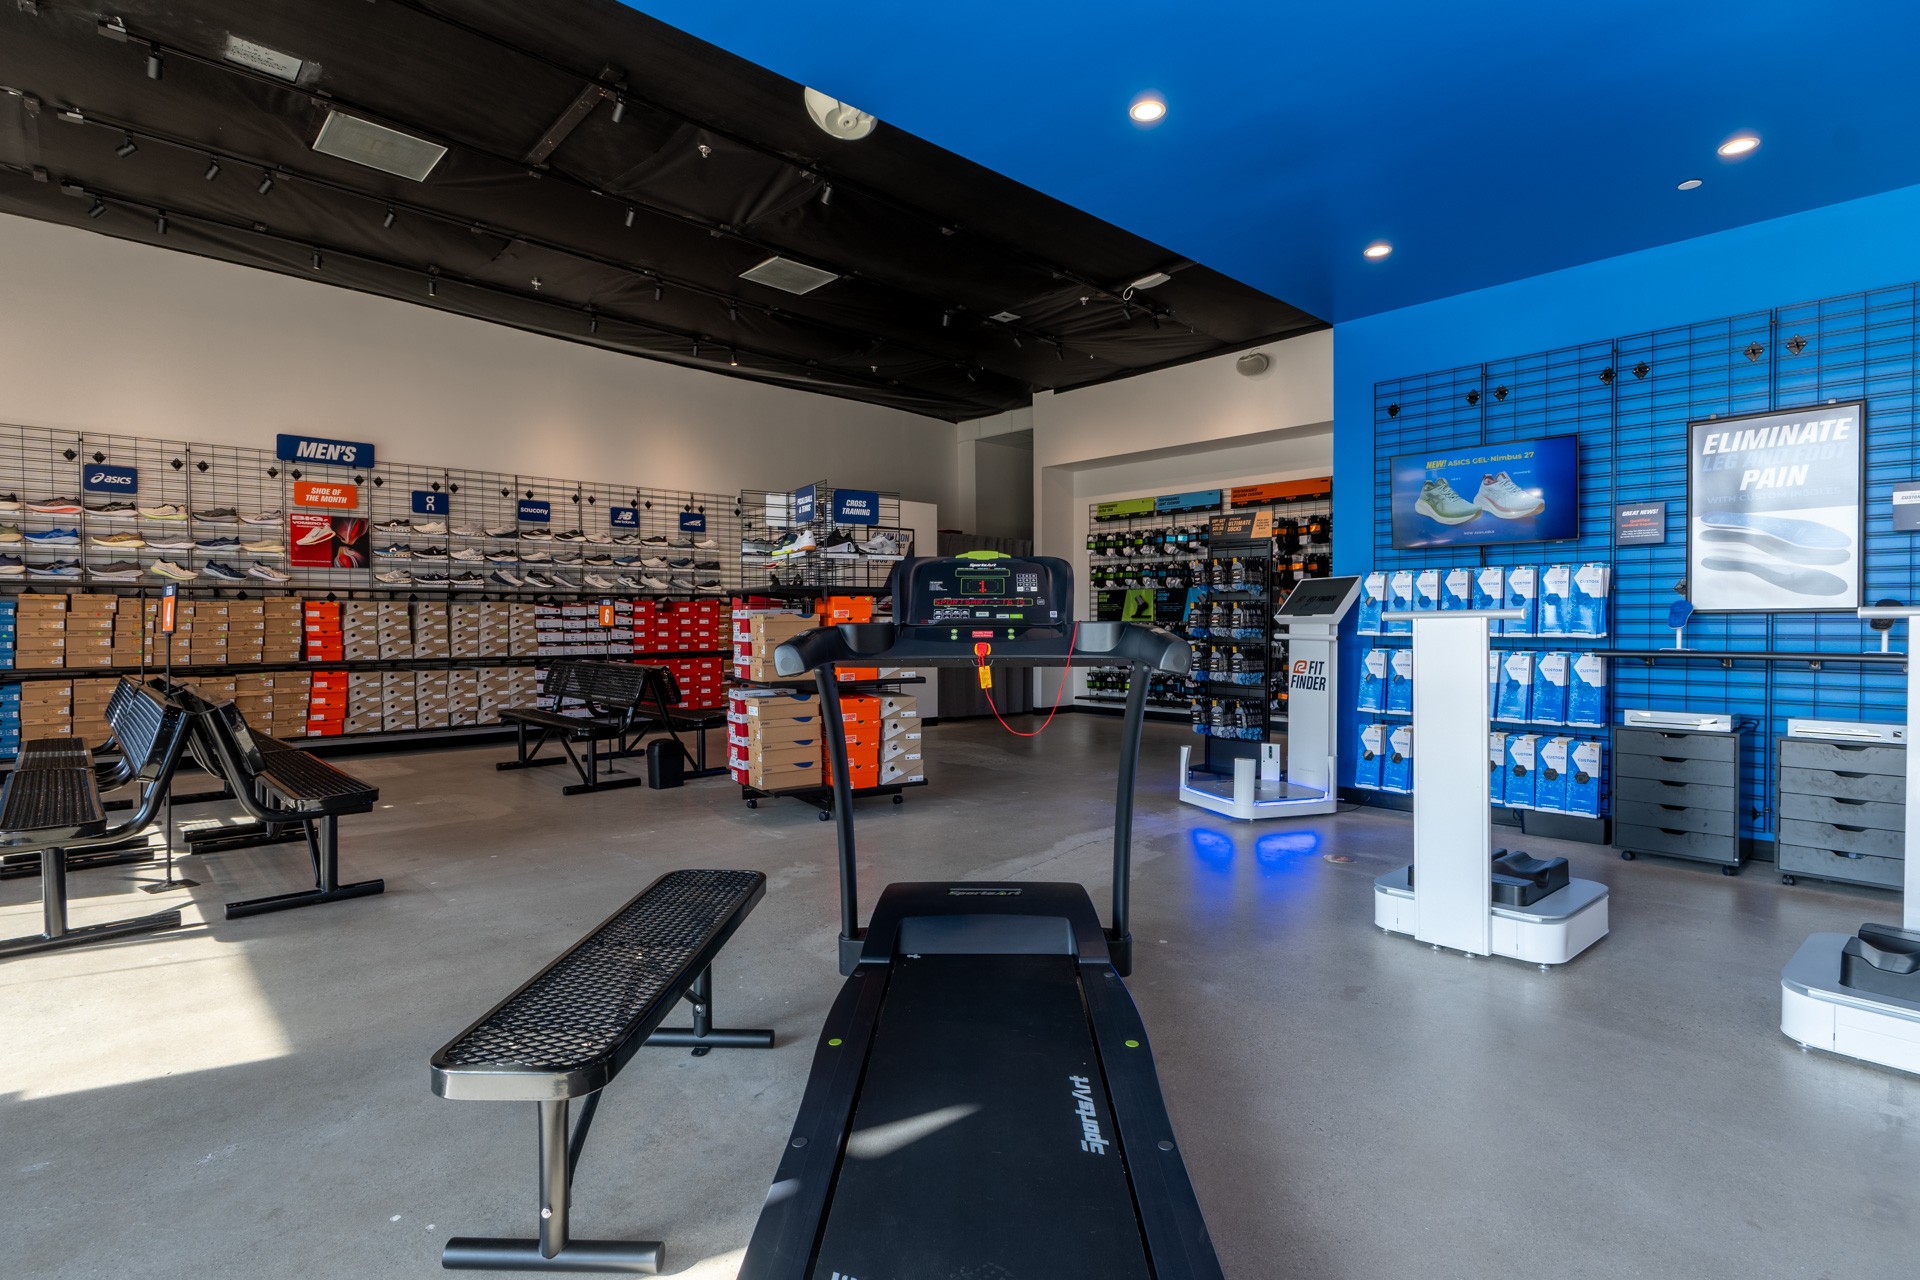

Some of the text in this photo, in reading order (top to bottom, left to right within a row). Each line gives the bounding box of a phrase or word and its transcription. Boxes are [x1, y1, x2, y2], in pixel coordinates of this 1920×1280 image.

[1702, 417, 1853, 455] ELIMINATE
[296, 441, 357, 462] MEN'S
[1702, 441, 1850, 472] LEG AND FOOT
[1426, 460, 1447, 469] NEW!
[1448, 458, 1471, 467] ASICS
[1524, 451, 1535, 459] 27
[104, 474, 132, 485] asics
[1739, 464, 1810, 491] PAIN
[305, 494, 348, 504] THE MONTH
[310, 487, 342, 496] SHOE OF
[1706, 486, 1842, 504] WITH CUSTOM INSOLES
[520, 506, 549, 515] saucony
[842, 507, 871, 516] TRAINING
[845, 499, 867, 508] CROSS
[604, 608, 610, 624] 6
[1308, 660, 1325, 675] FIT
[1290, 675, 1327, 691] FINDER
[1069, 1075, 1110, 1155] SportsArt
